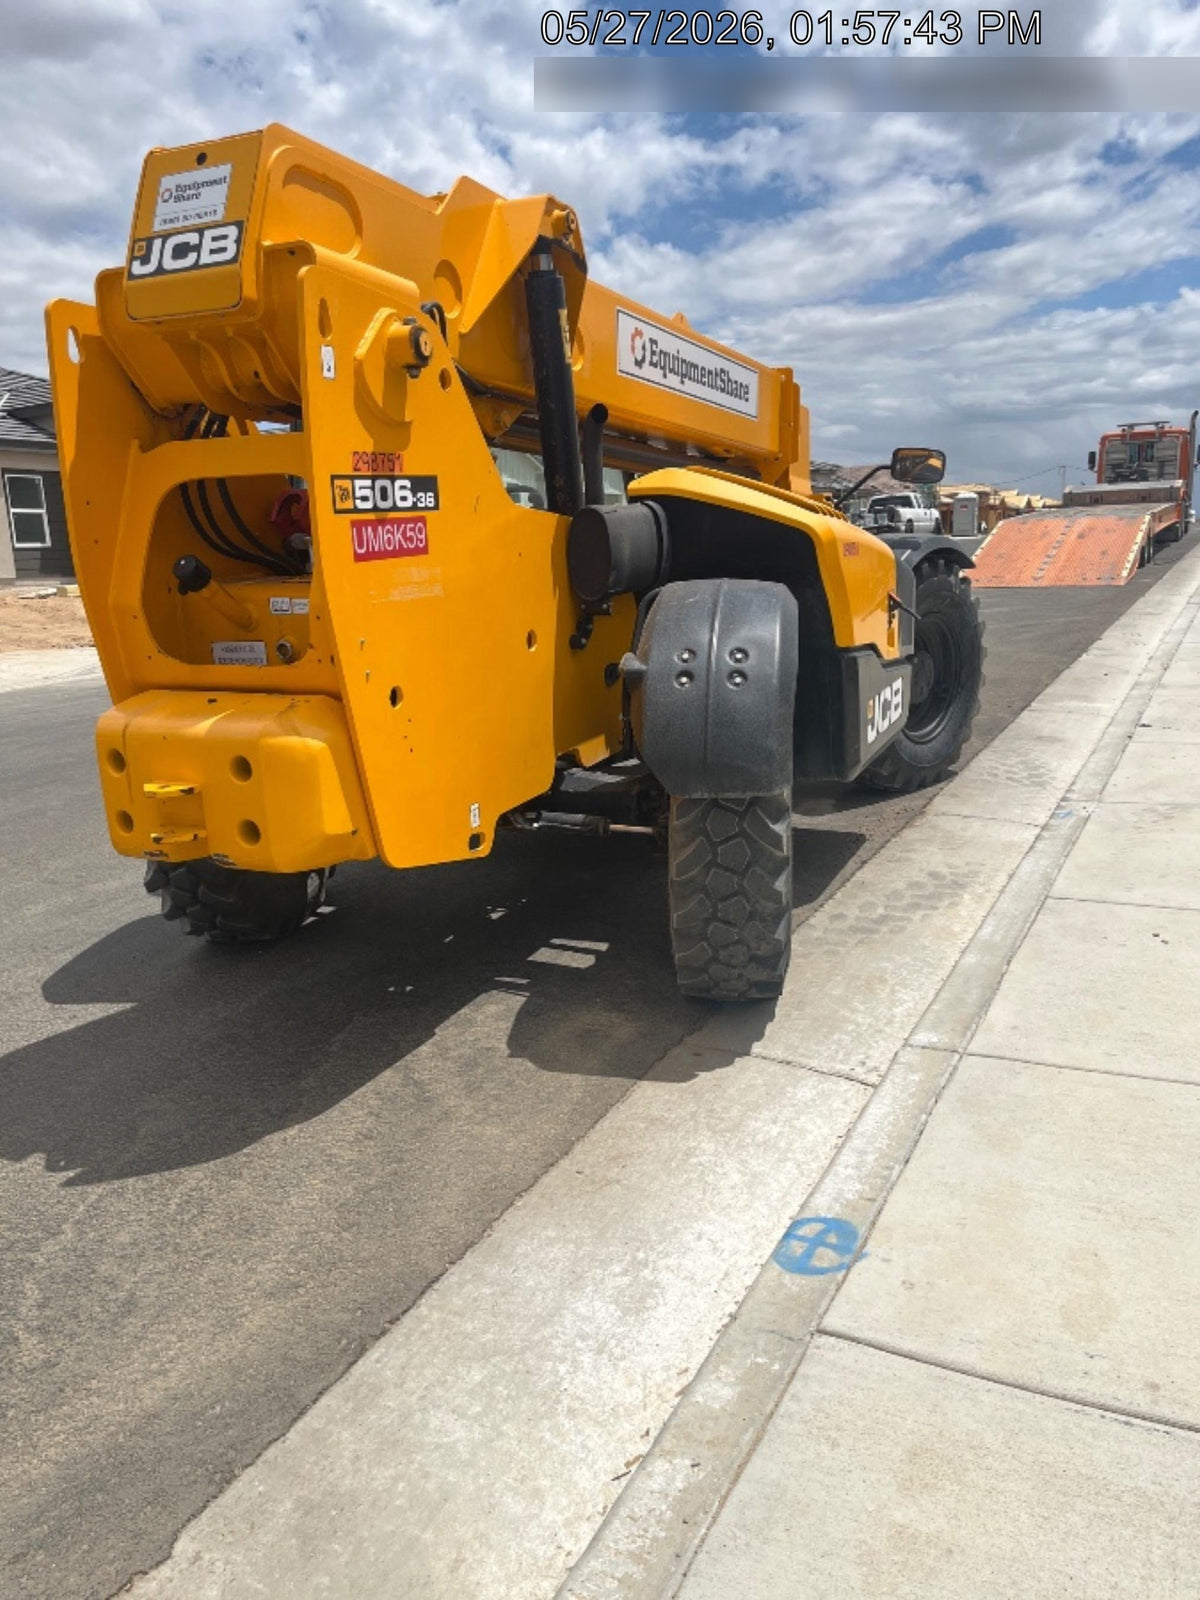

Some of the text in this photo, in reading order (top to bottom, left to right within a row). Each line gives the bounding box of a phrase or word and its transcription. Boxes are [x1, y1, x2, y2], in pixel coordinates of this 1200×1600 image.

[173, 192, 201, 203] Share
[174, 176, 227, 194] Equipment
[131, 225, 239, 275] JCB
[648, 337, 750, 402] EquipmentShare
[353, 522, 426, 554] UM6K59
[867, 677, 903, 744] JCB
